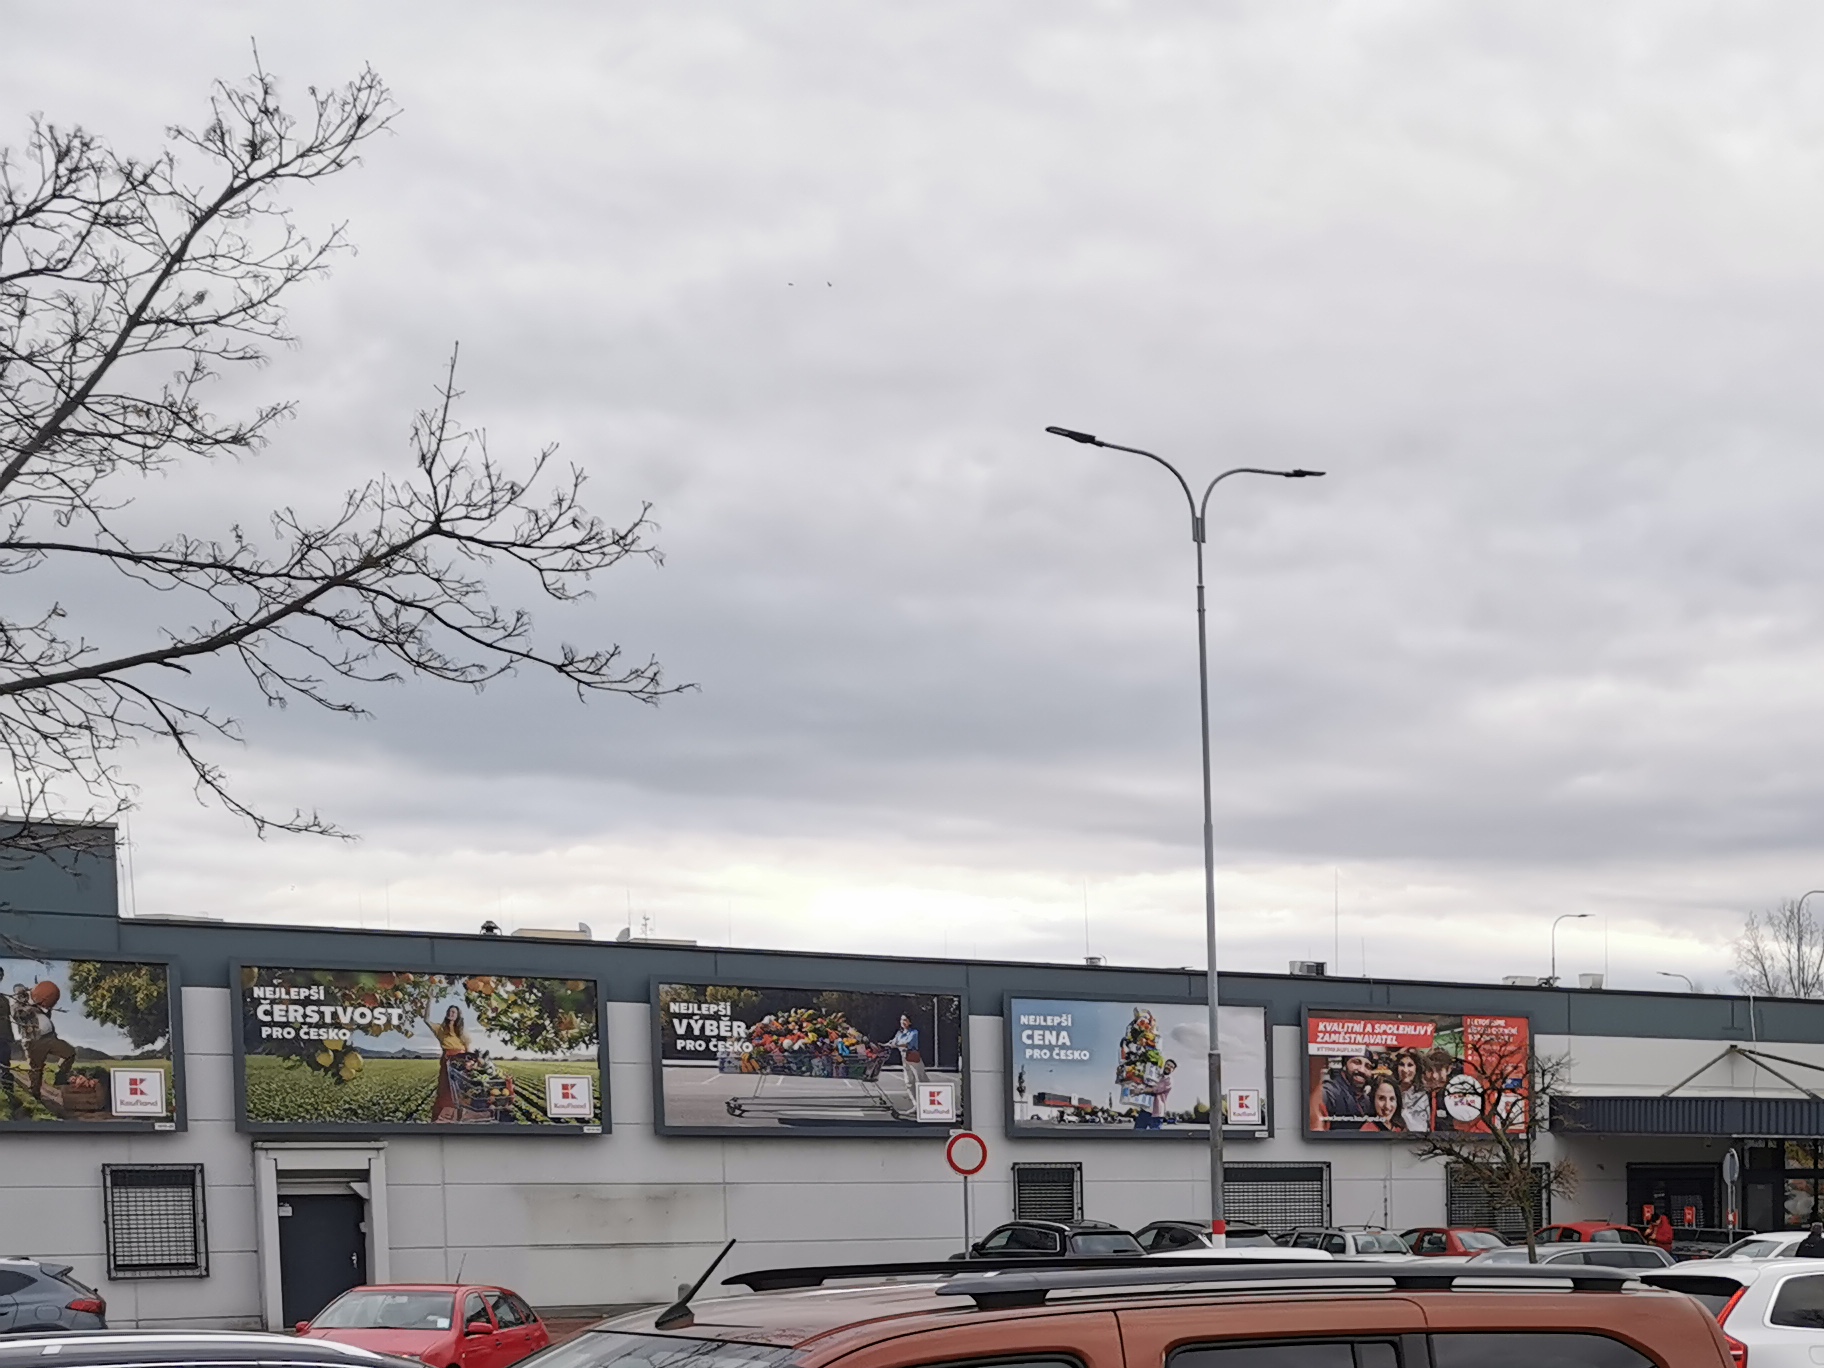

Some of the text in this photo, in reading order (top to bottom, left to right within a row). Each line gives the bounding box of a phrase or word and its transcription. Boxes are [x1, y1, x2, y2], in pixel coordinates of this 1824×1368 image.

[253, 985, 325, 1000] NEJLEPŠÍ
[256, 1000, 403, 1026] ČERSTVOST
[669, 1001, 732, 1016] NEJLEPŠÍ
[672, 1015, 747, 1038] VÝBĚR
[1020, 1013, 1072, 1027] NEJLEPŠÍ
[261, 1024, 351, 1041] PRO ČESKO
[1317, 1020, 1436, 1037] KVALITNÍ A SPOLEHLIVÝ
[676, 1037, 754, 1053] PRO ČESKO
[1021, 1029, 1071, 1046] CENA
[1316, 1031, 1399, 1046] ZAMĚSTNAVATEL
[1025, 1046, 1090, 1061] PRO ČESKO
